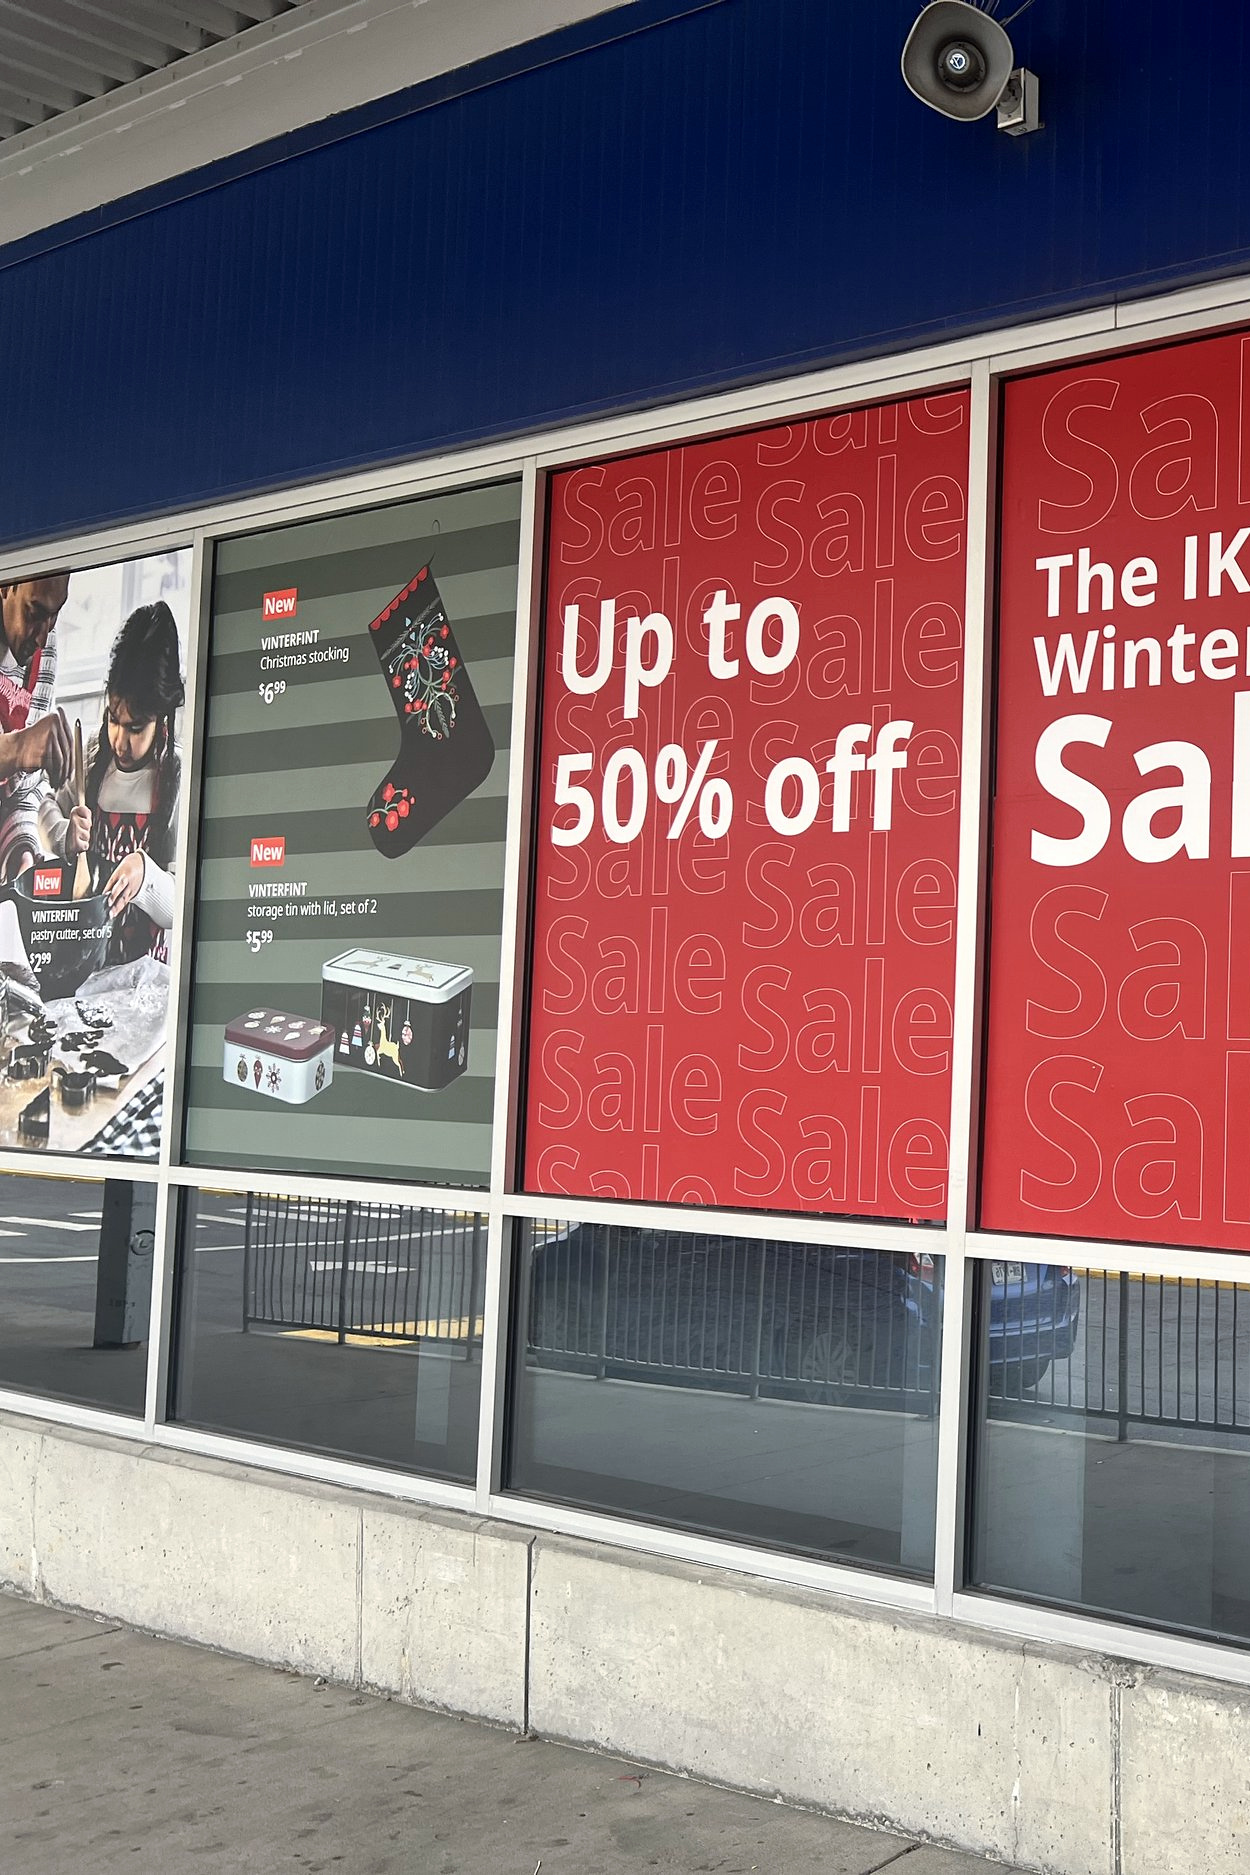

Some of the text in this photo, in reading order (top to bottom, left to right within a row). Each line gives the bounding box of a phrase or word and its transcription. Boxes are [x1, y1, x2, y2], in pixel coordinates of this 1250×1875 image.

[560, 448, 741, 564] Sale
[753, 454, 965, 586] Sale
[265, 597, 295, 615] New
[1036, 548, 1158, 618] The
[260, 646, 350, 670] Christmas stocking
[261, 629, 320, 651] VINTERFINT
[562, 589, 801, 719] Up to
[551, 720, 914, 847] 50% off
[35, 875, 60, 891] New
[252, 844, 283, 861] New
[31, 909, 80, 923] VINTERFINT
[247, 899, 378, 920] storage tin with lid, set of 2
[249, 882, 307, 898] VINTERFINT
[742, 831, 957, 949] Sale
[30, 925, 113, 944] pastry cutter, set of 5
[543, 906, 726, 1014] Sale
[738, 958, 953, 1075] Sale
[538, 1025, 722, 1136] Sale
[733, 1086, 949, 1208] Sale
